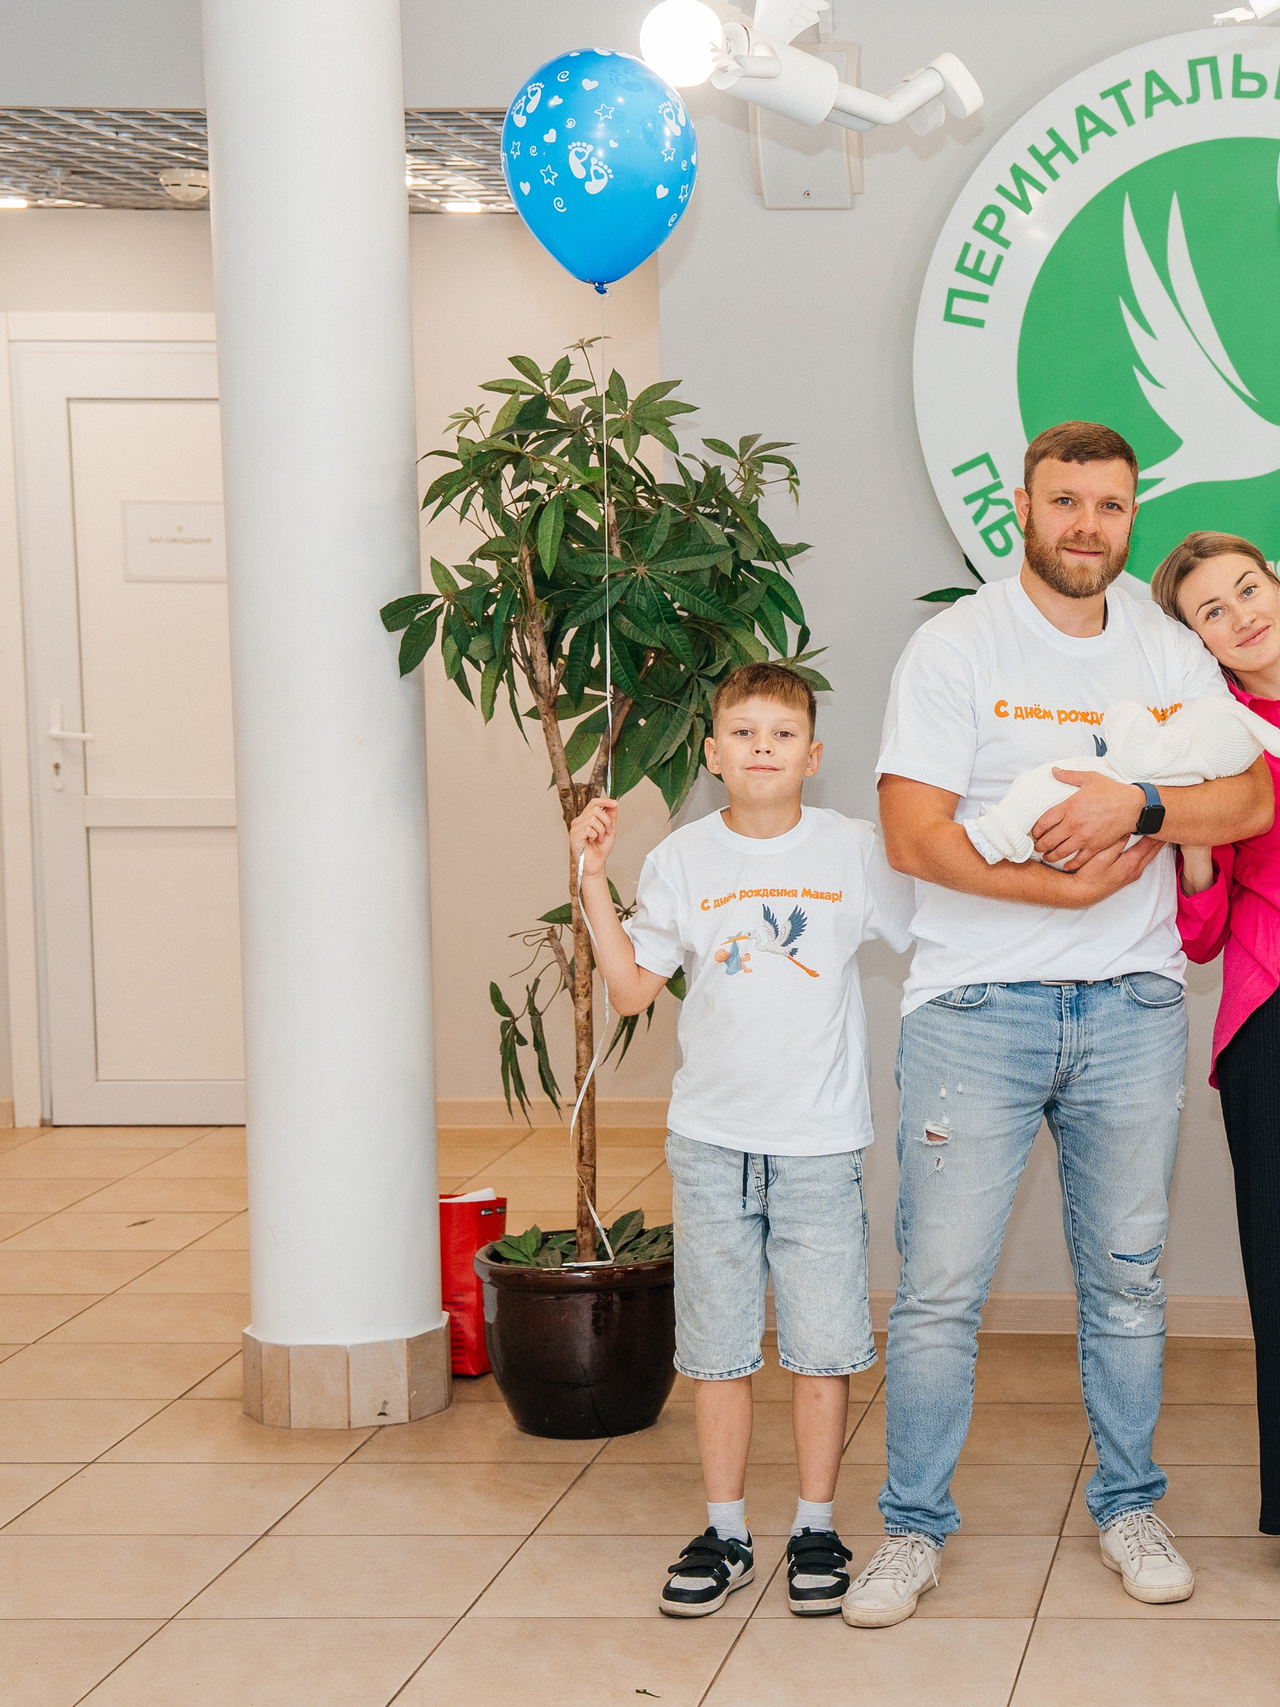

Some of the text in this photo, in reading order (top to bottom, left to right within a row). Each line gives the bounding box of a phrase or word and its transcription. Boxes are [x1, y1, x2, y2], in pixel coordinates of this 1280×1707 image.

[951, 451, 1025, 558] ГКБ
[994, 699, 1009, 718] С
[1013, 704, 1054, 721] днём
[700, 898, 711, 912] С
[738, 887, 798, 901] рождения
[801, 887, 842, 903] Макар!
